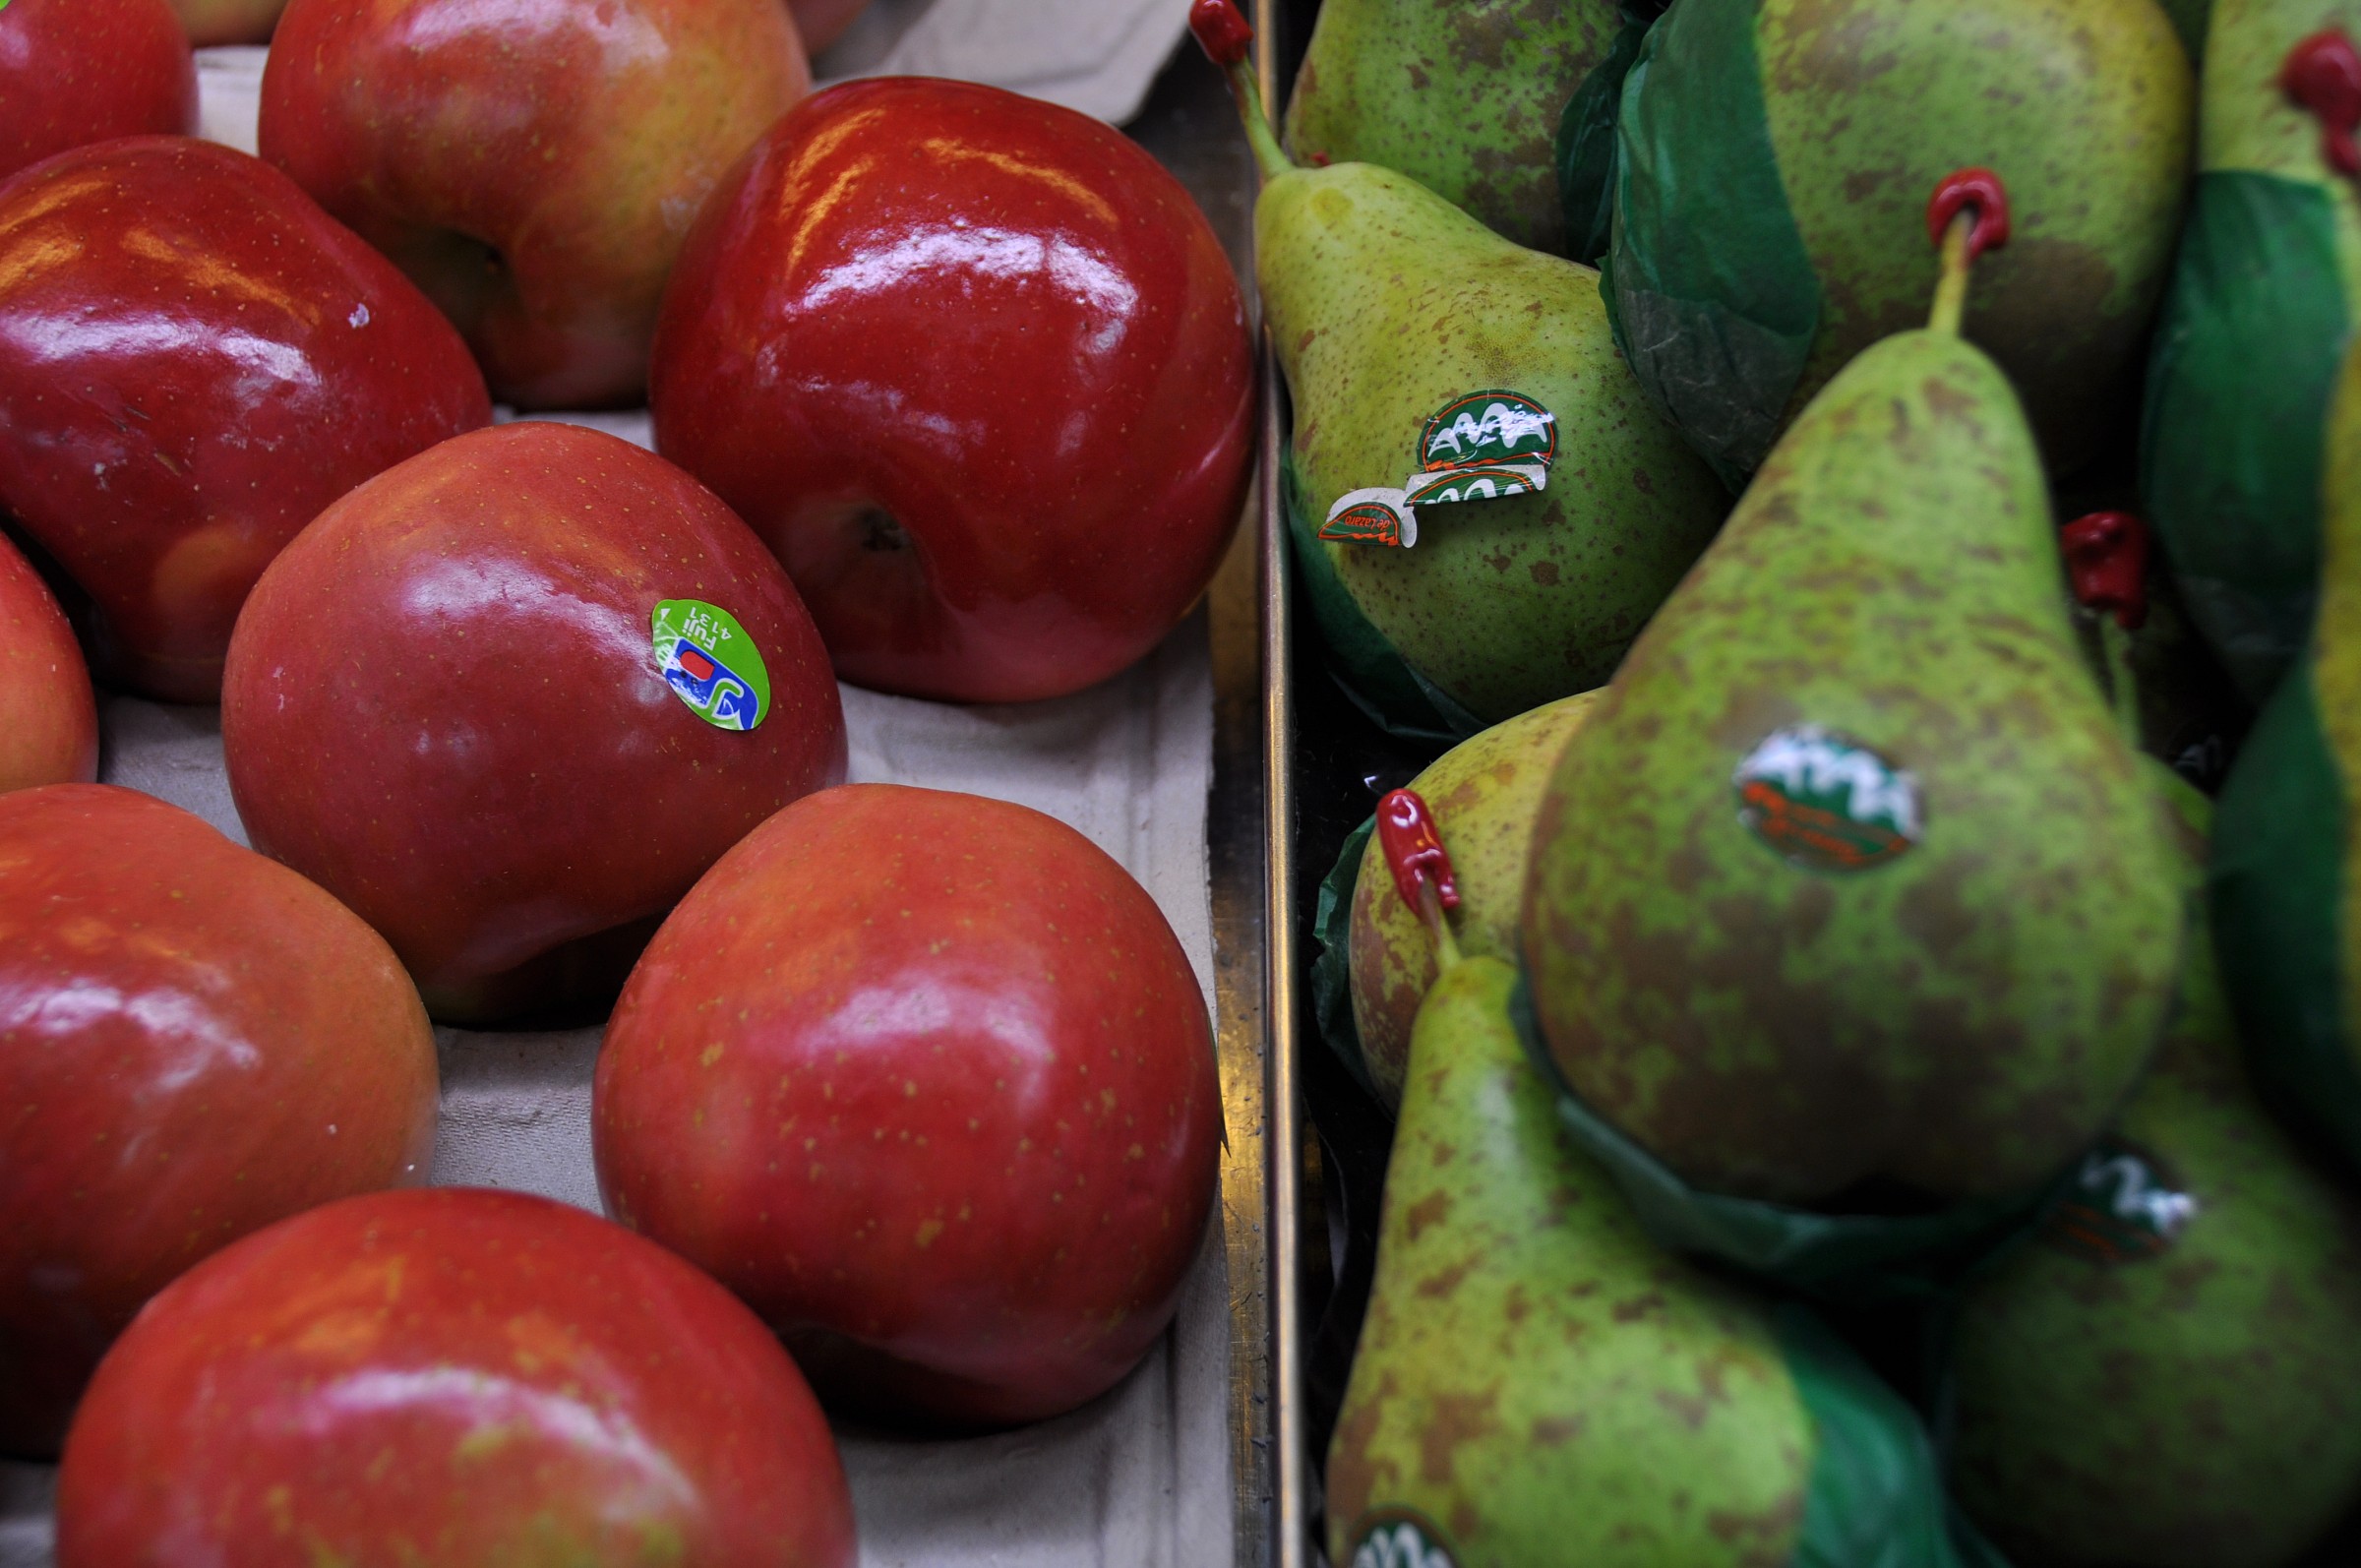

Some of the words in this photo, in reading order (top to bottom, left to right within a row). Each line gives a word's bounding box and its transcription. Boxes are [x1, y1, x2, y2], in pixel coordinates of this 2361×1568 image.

[1345, 515, 1376, 530] Lazaro
[1377, 518, 1391, 531] de
[682, 618, 717, 651] Fuji
[690, 606, 732, 640] 4131
